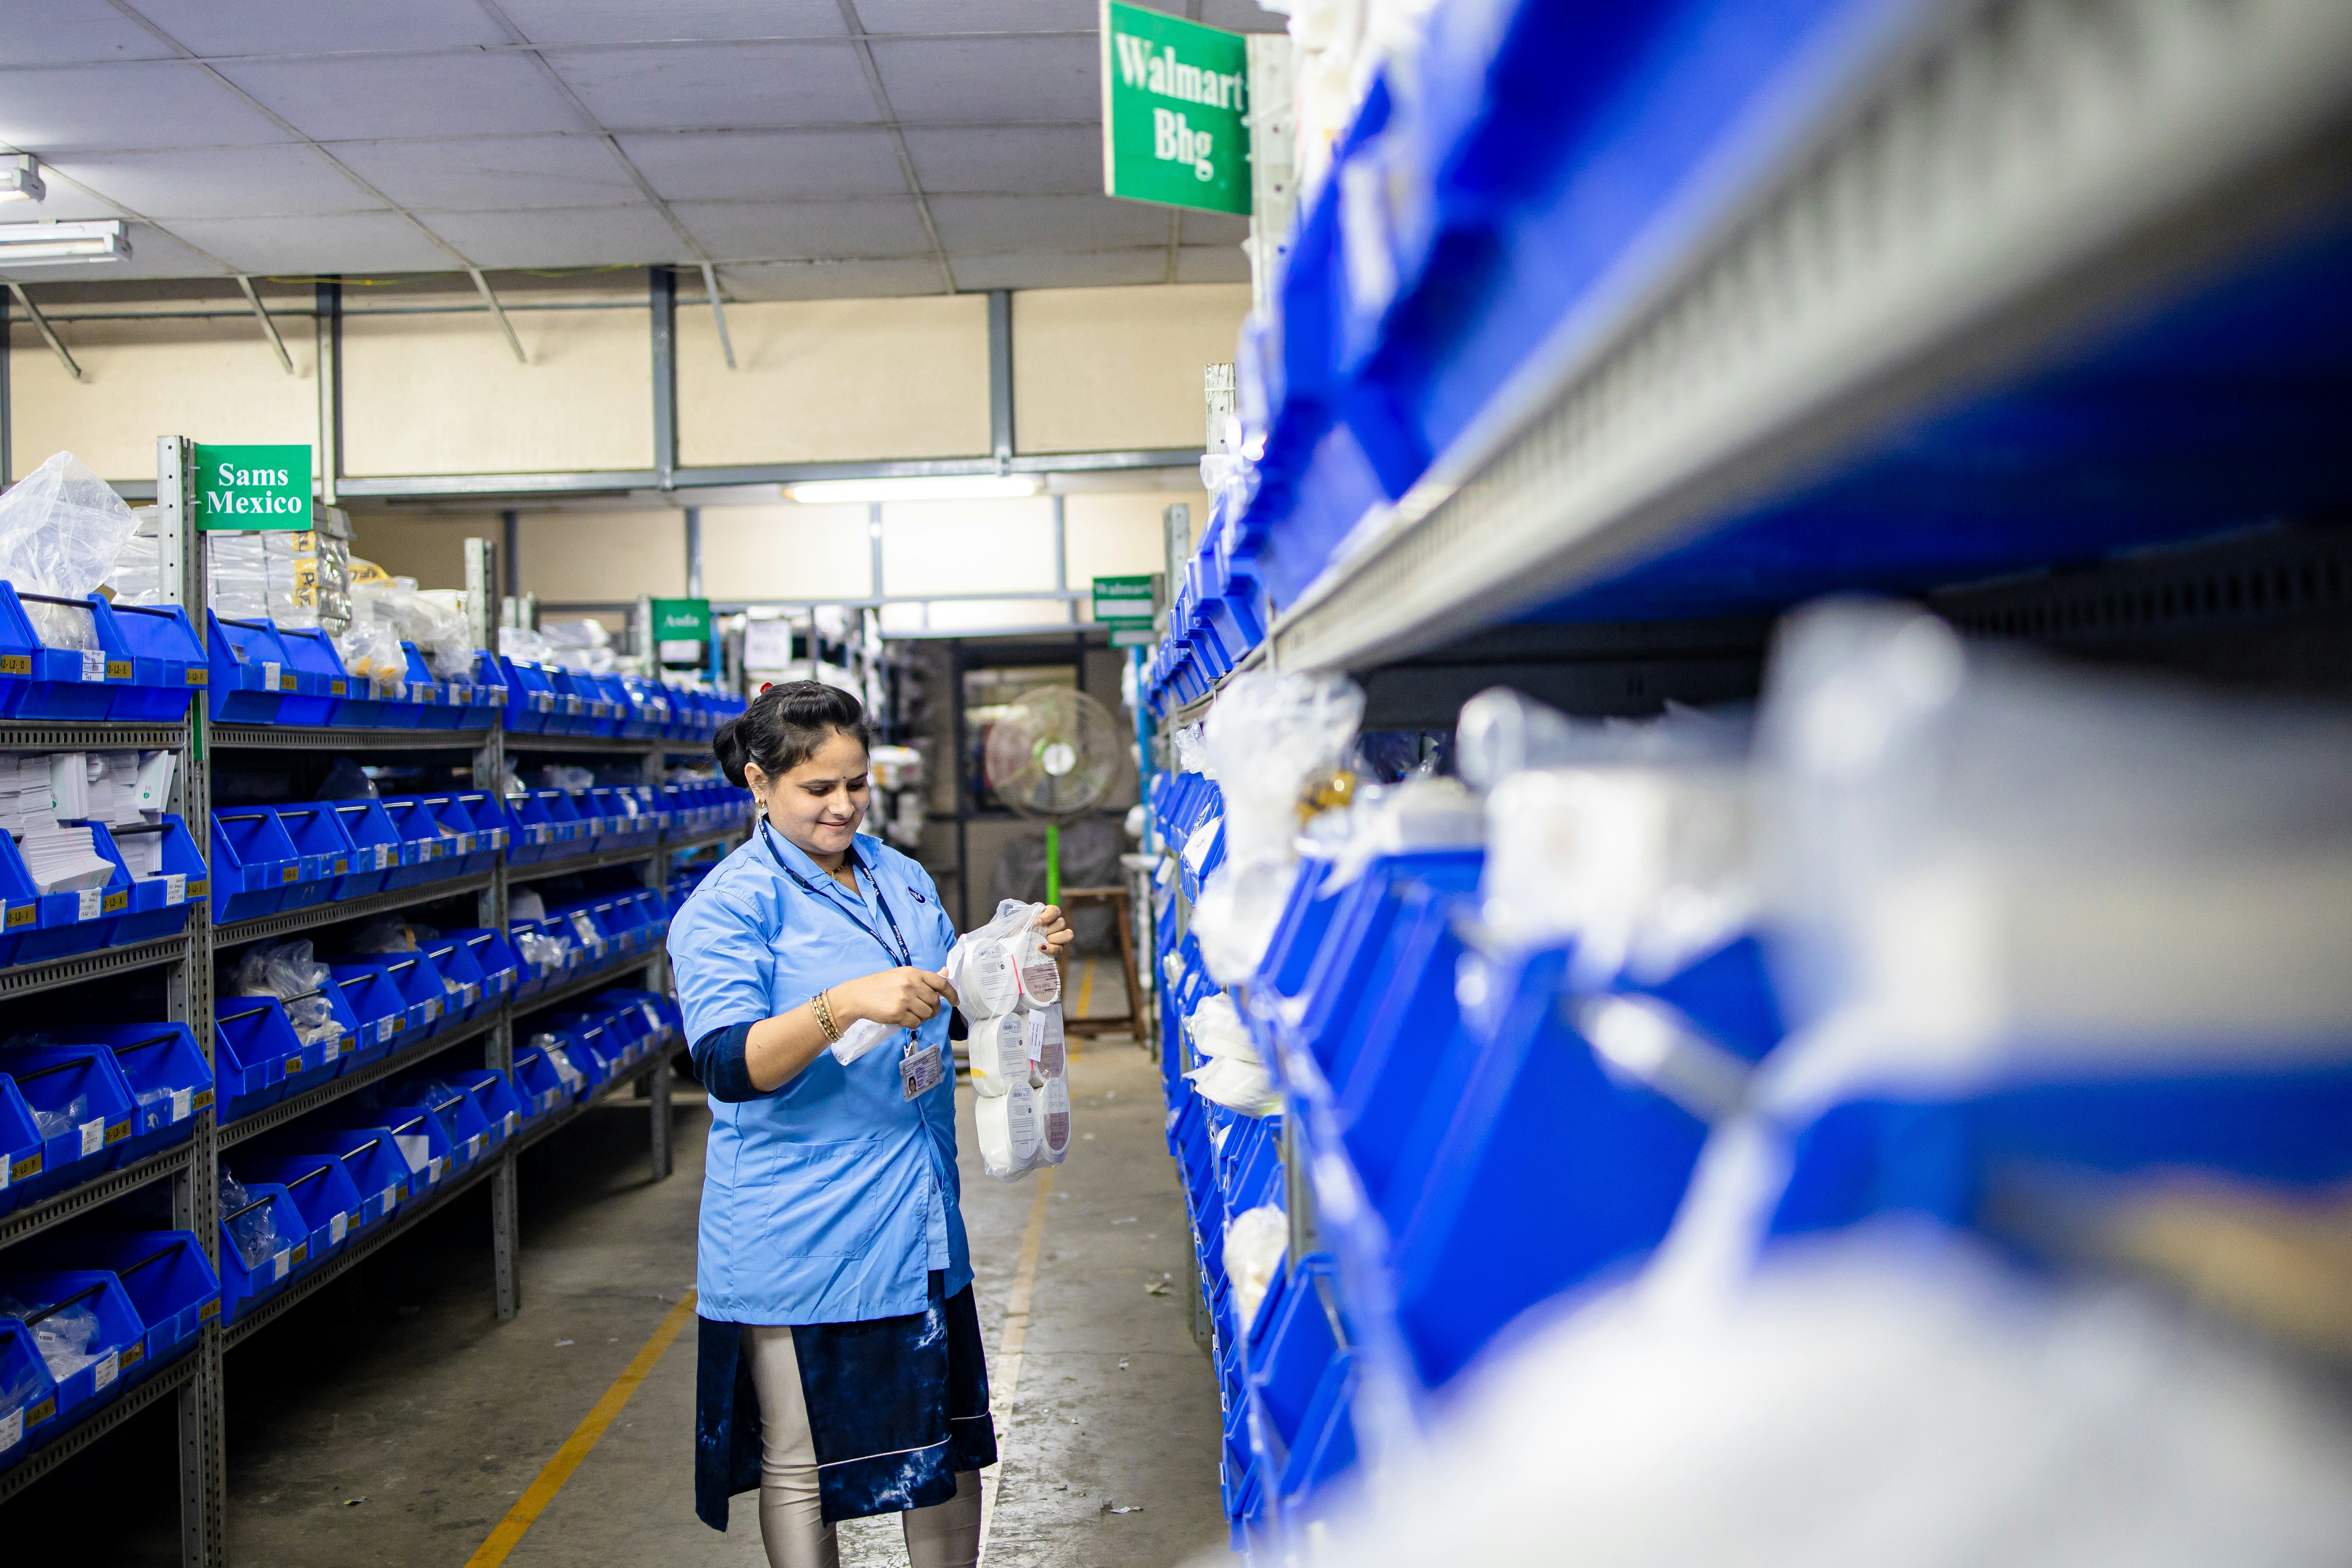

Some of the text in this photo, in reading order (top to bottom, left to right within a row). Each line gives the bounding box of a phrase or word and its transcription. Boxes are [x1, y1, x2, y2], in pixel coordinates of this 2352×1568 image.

[1116, 32, 1243, 111] Walmart
[1152, 107, 1214, 182] Bhg
[219, 463, 289, 486] Sams
[206, 490, 302, 514] Mexico
[893, 925, 904, 945] Welspun
